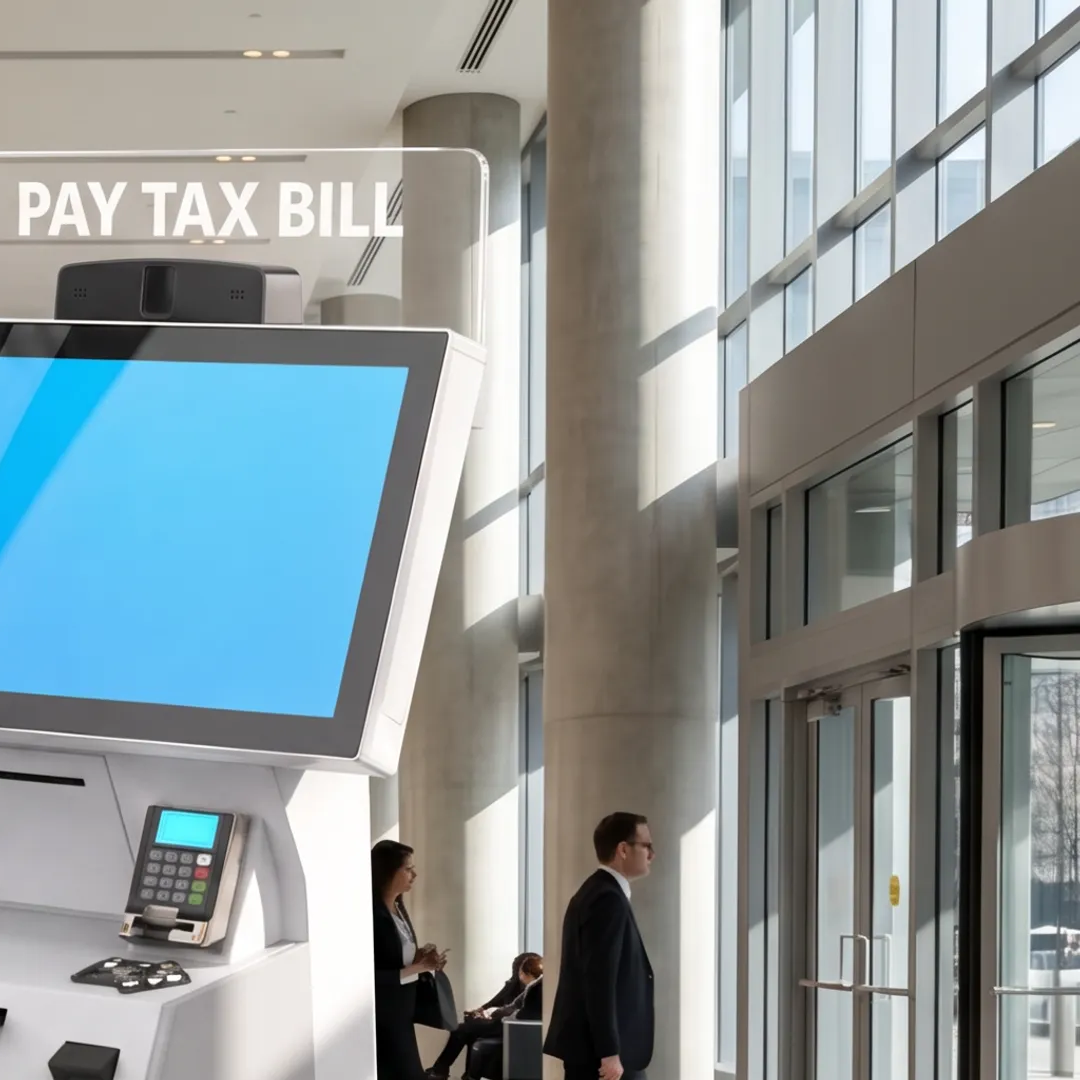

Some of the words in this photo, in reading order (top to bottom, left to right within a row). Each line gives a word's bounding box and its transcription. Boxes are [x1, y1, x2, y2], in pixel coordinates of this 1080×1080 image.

[18, 181, 128, 237] PAY
[141, 181, 260, 237] TAX
[278, 181, 404, 238] BILL
